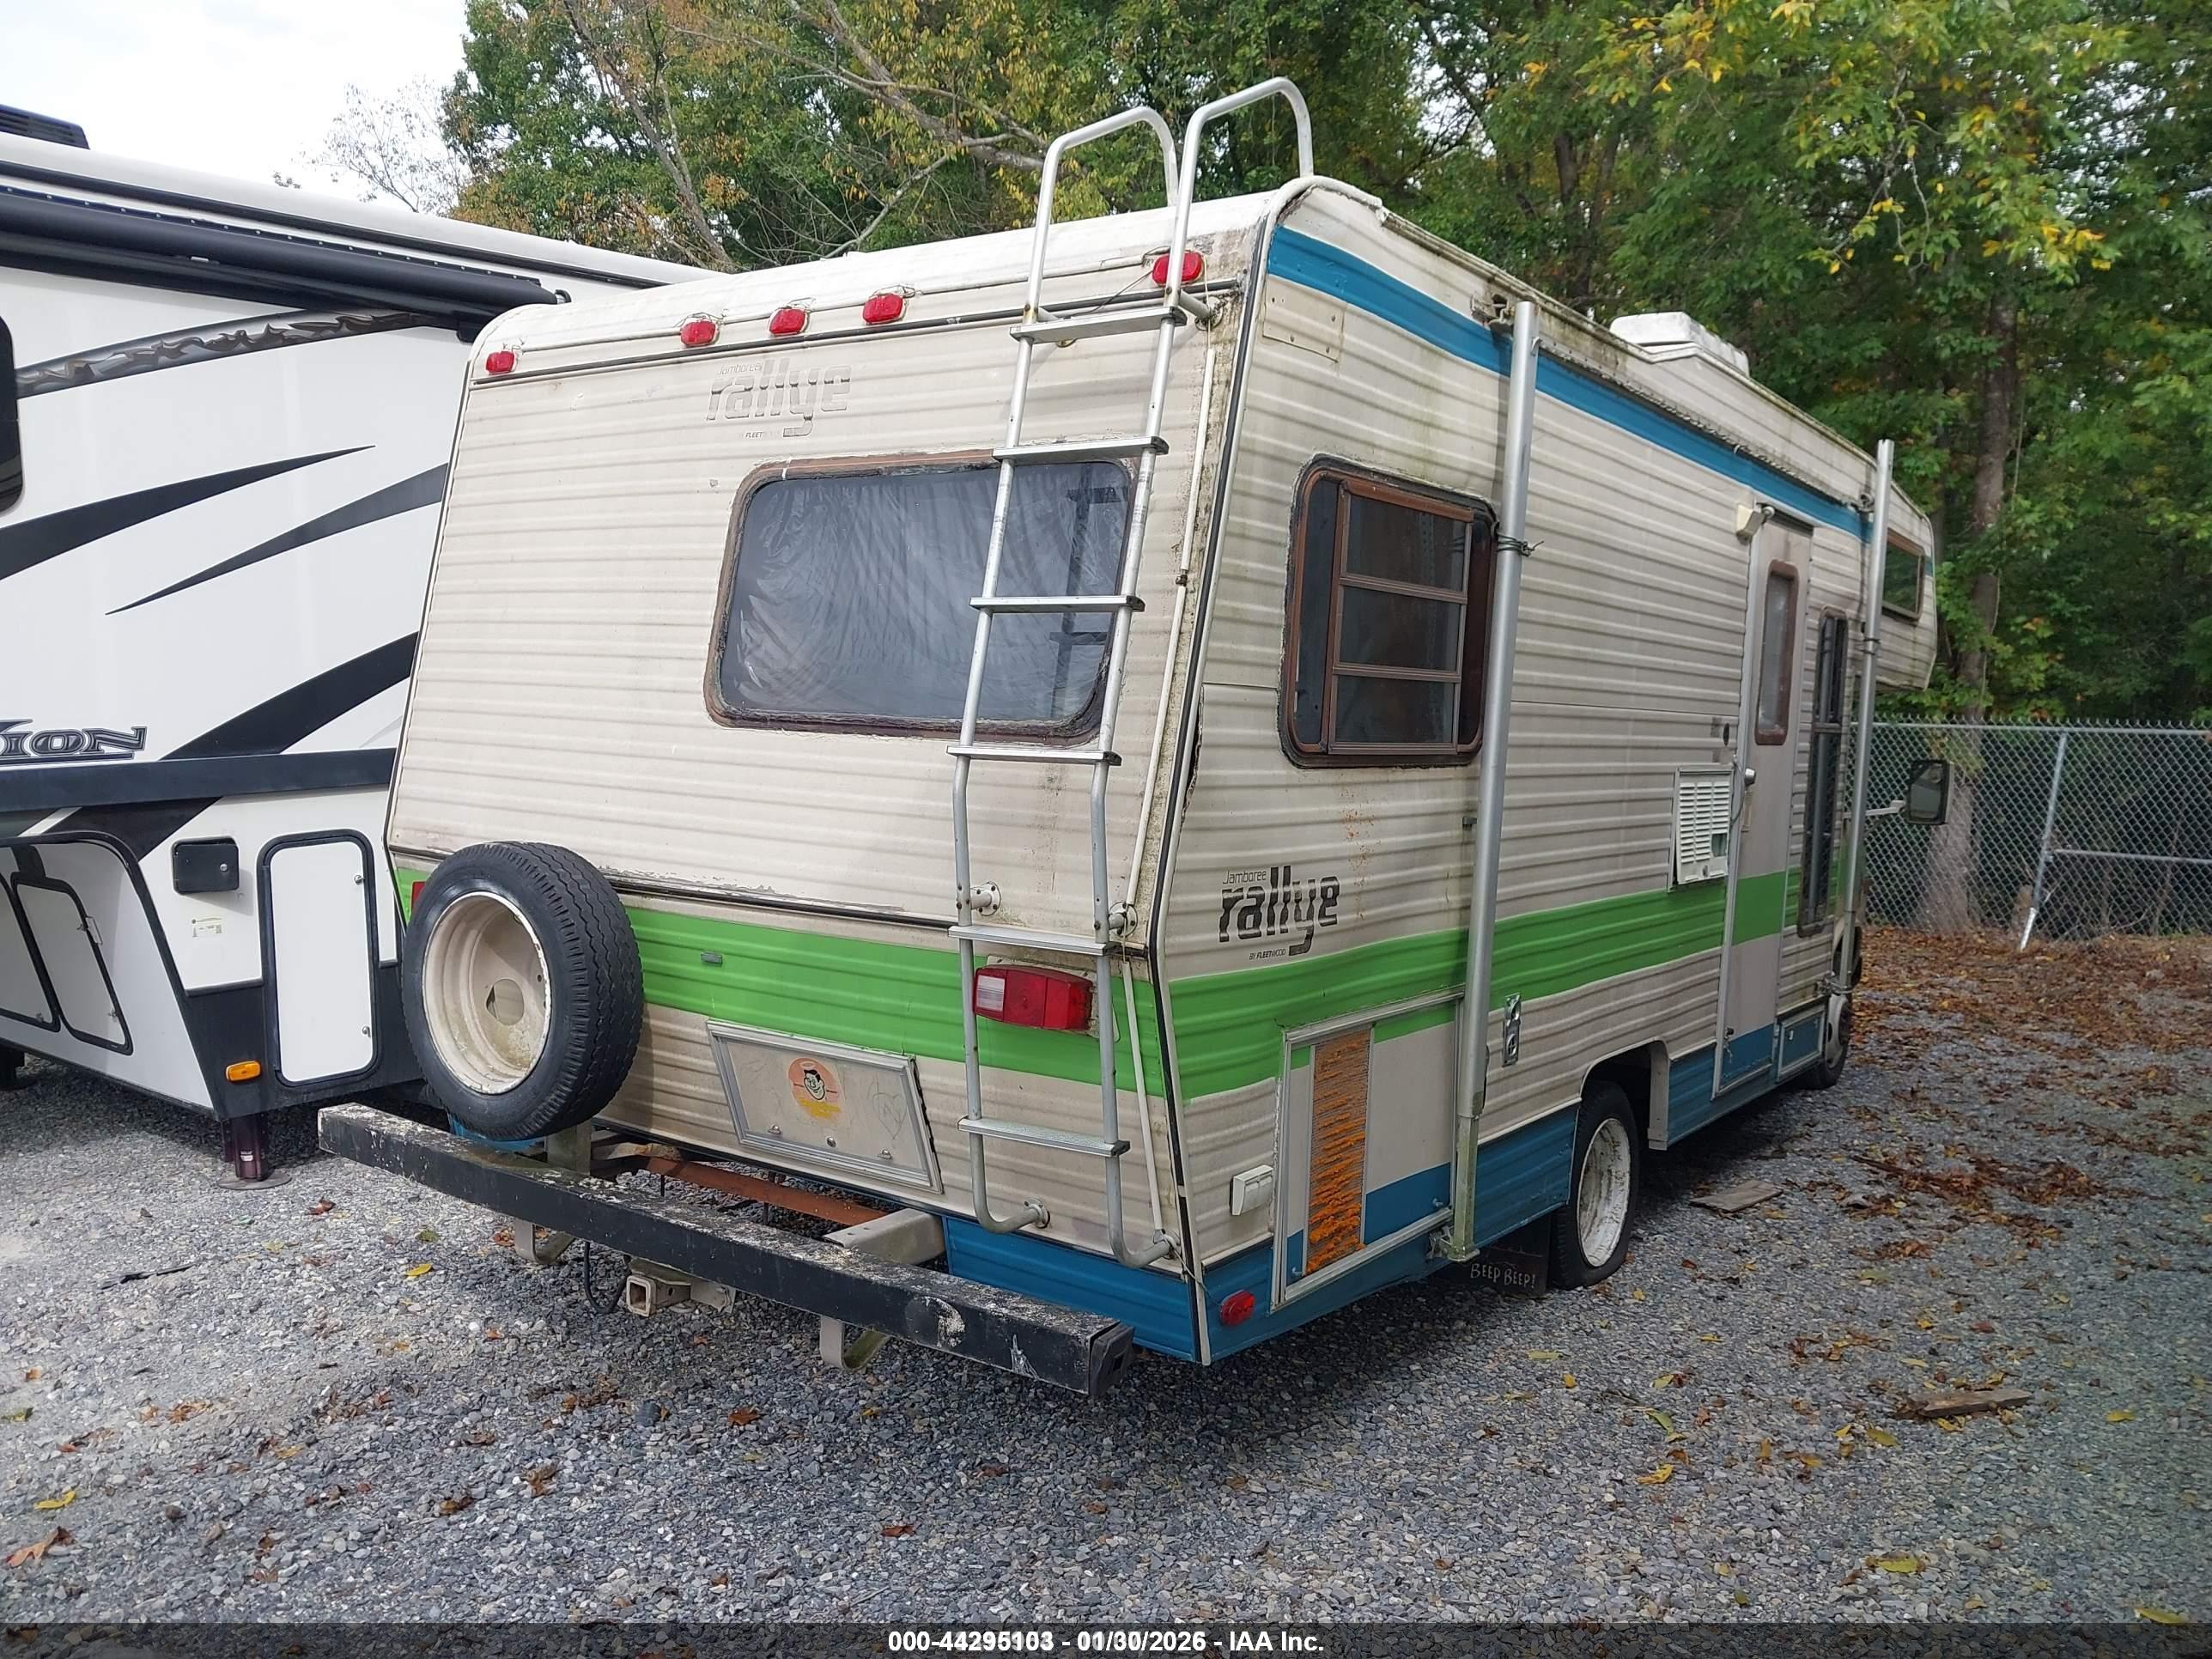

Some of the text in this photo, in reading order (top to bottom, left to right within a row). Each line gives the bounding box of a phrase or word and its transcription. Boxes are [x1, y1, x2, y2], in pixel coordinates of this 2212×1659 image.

[706, 357, 853, 438] rallye
[0, 719, 148, 757] ION
[1222, 870, 1267, 884] Jamboree
[1219, 866, 1340, 956] rallye
[1249, 948, 1286, 960] BY FLEETWOOD
[1470, 1263, 1536, 1288] BEEP BEEP!
